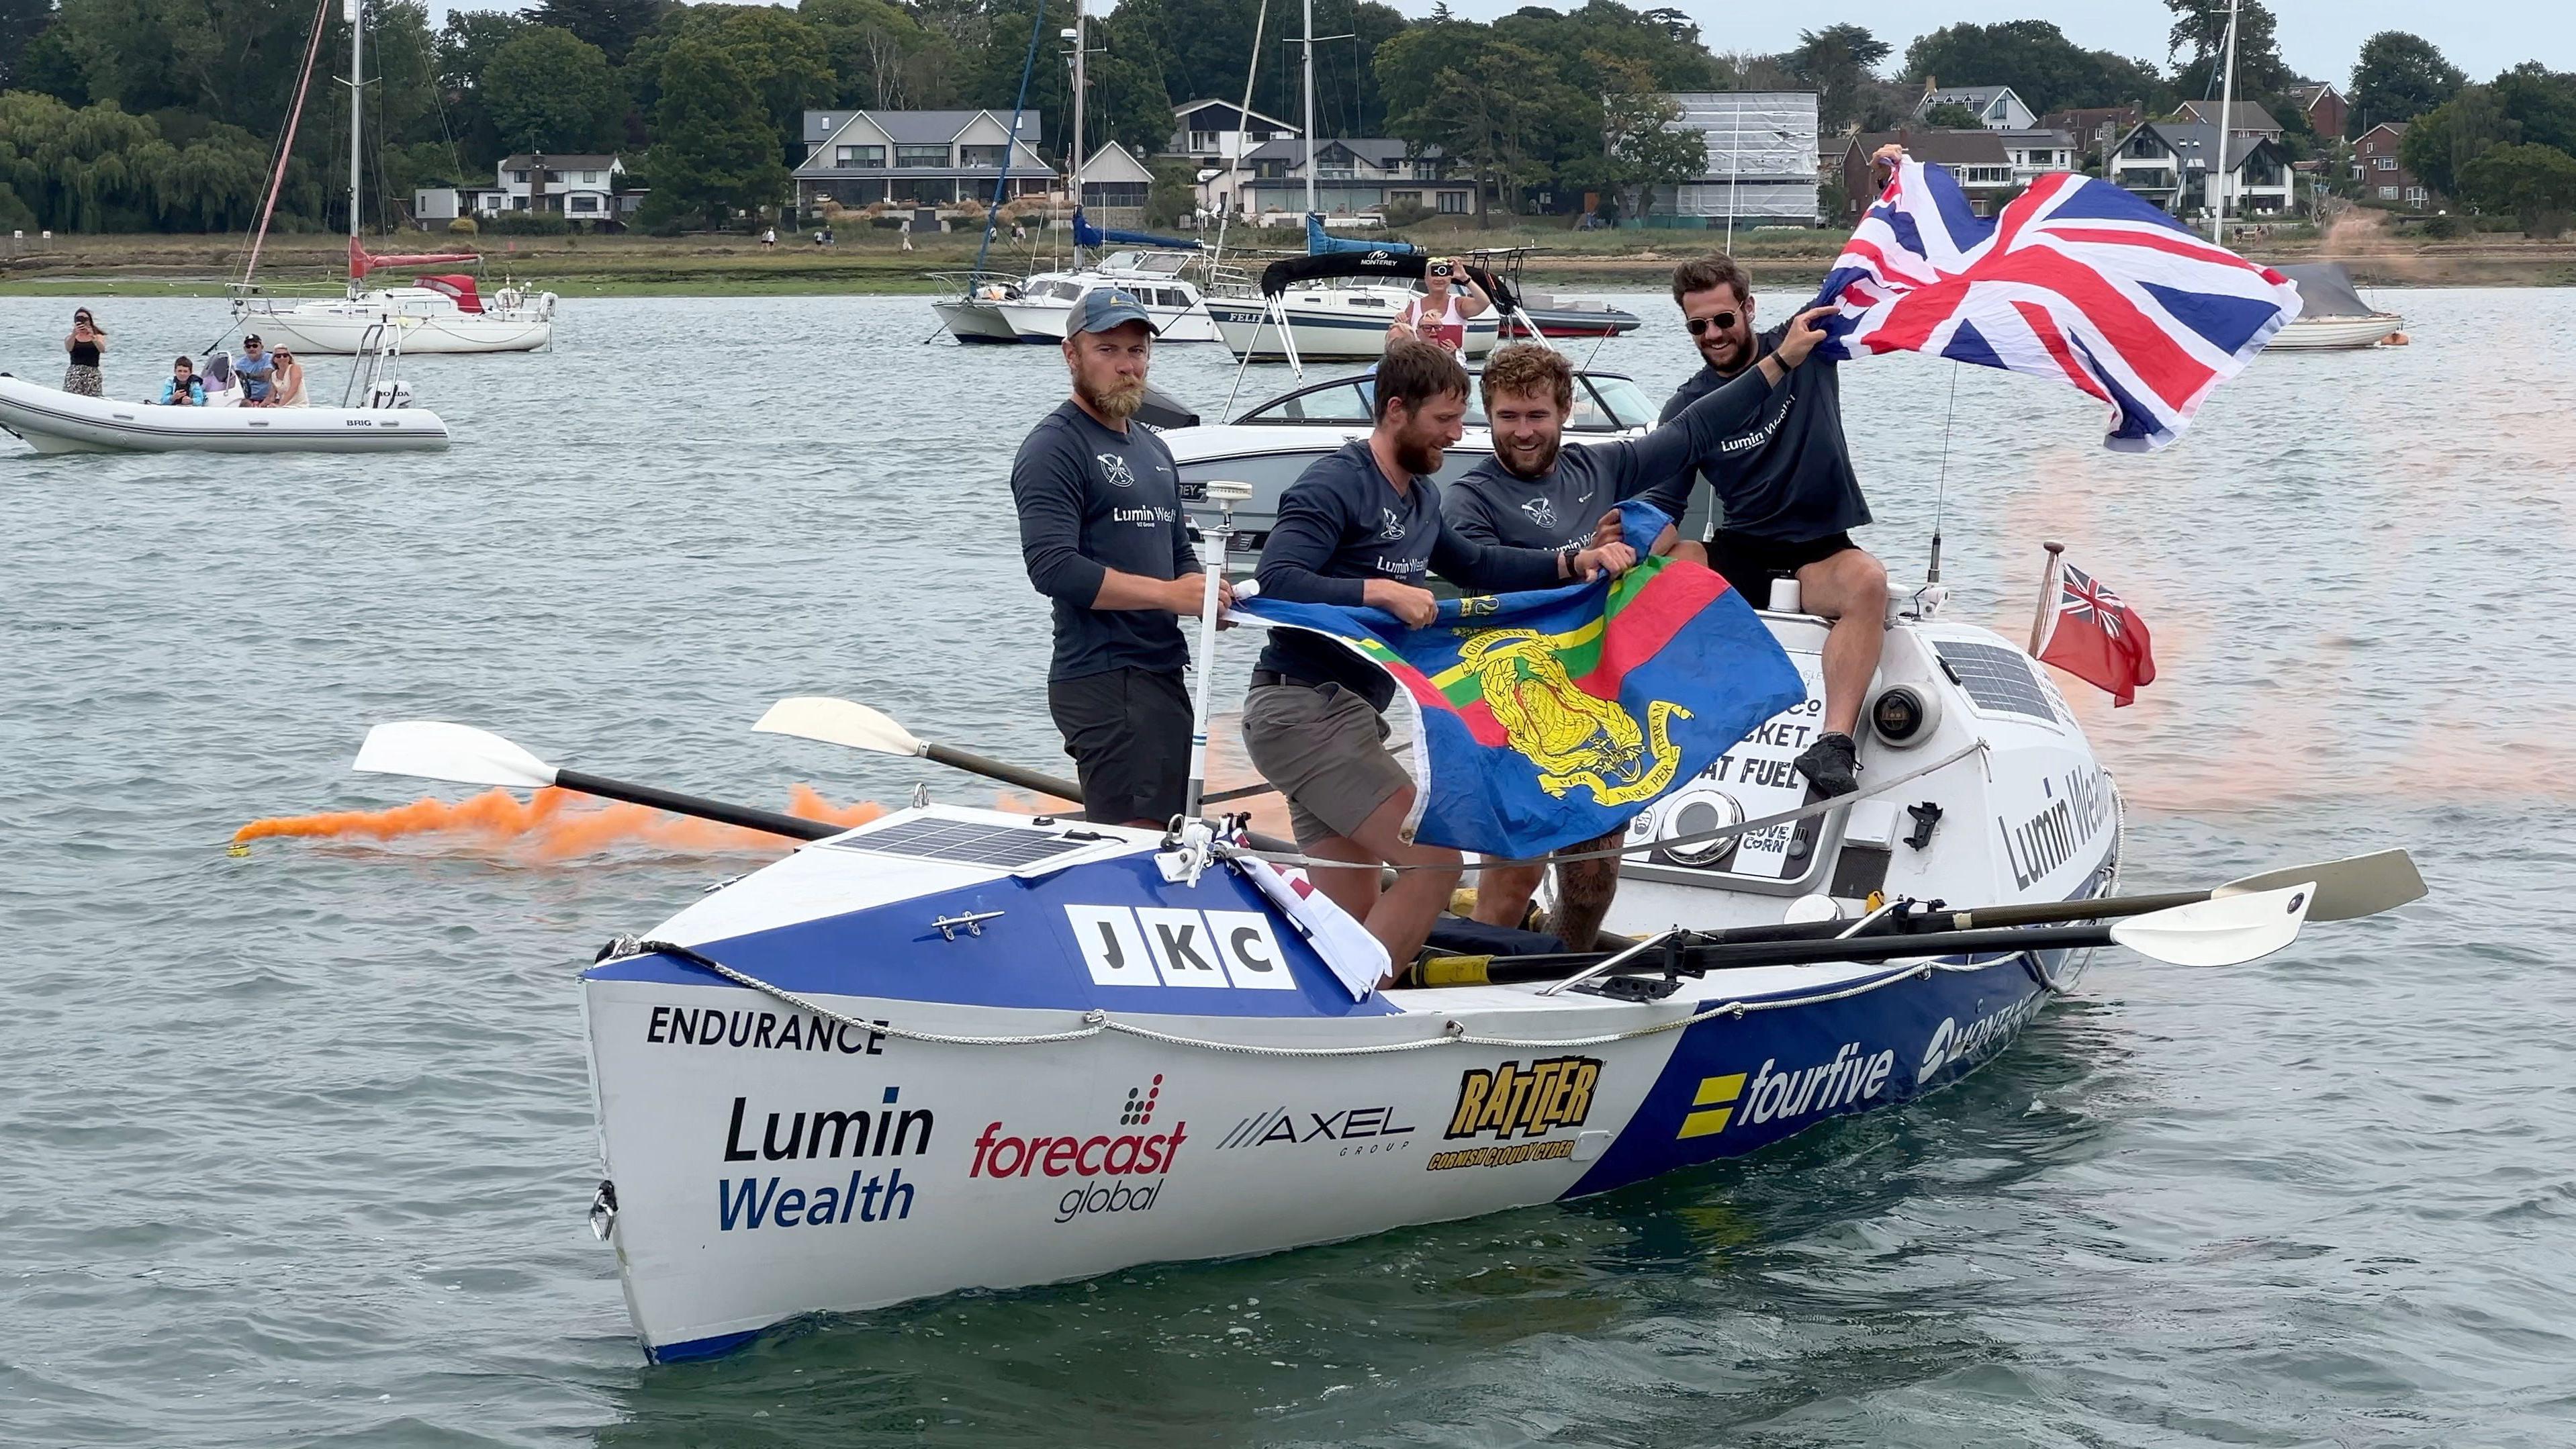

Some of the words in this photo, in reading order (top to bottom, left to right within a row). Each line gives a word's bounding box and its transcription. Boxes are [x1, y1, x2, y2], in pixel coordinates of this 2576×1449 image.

[1720, 432, 1764, 453] Lumin
[1113, 505, 1154, 522] Lumin
[1376, 555, 1410, 574] Lumin
[1745, 722, 1811, 749] KET
[1651, 764, 1672, 787] PER
[1739, 757, 1799, 790] FUEL
[1998, 777, 2077, 892] Lumin
[1097, 921, 1274, 972] JKC
[647, 1006, 890, 1056] ENDURANCE
[1444, 1056, 1603, 1139] RATTLER
[1737, 1041, 1894, 1127] fourfive
[723, 1086, 933, 1162] Lumin
[1255, 1106, 1416, 1147] AXEL
[970, 1121, 1189, 1178] forecast
[1339, 1140, 1410, 1157] GROUP
[1427, 1148, 1489, 1171] CORNISH
[1483, 1142, 1539, 1167] CLOUDY
[1533, 1140, 1575, 1162] CYDER
[719, 1168, 915, 1231] Wealth
[1054, 1178, 1164, 1223] global
